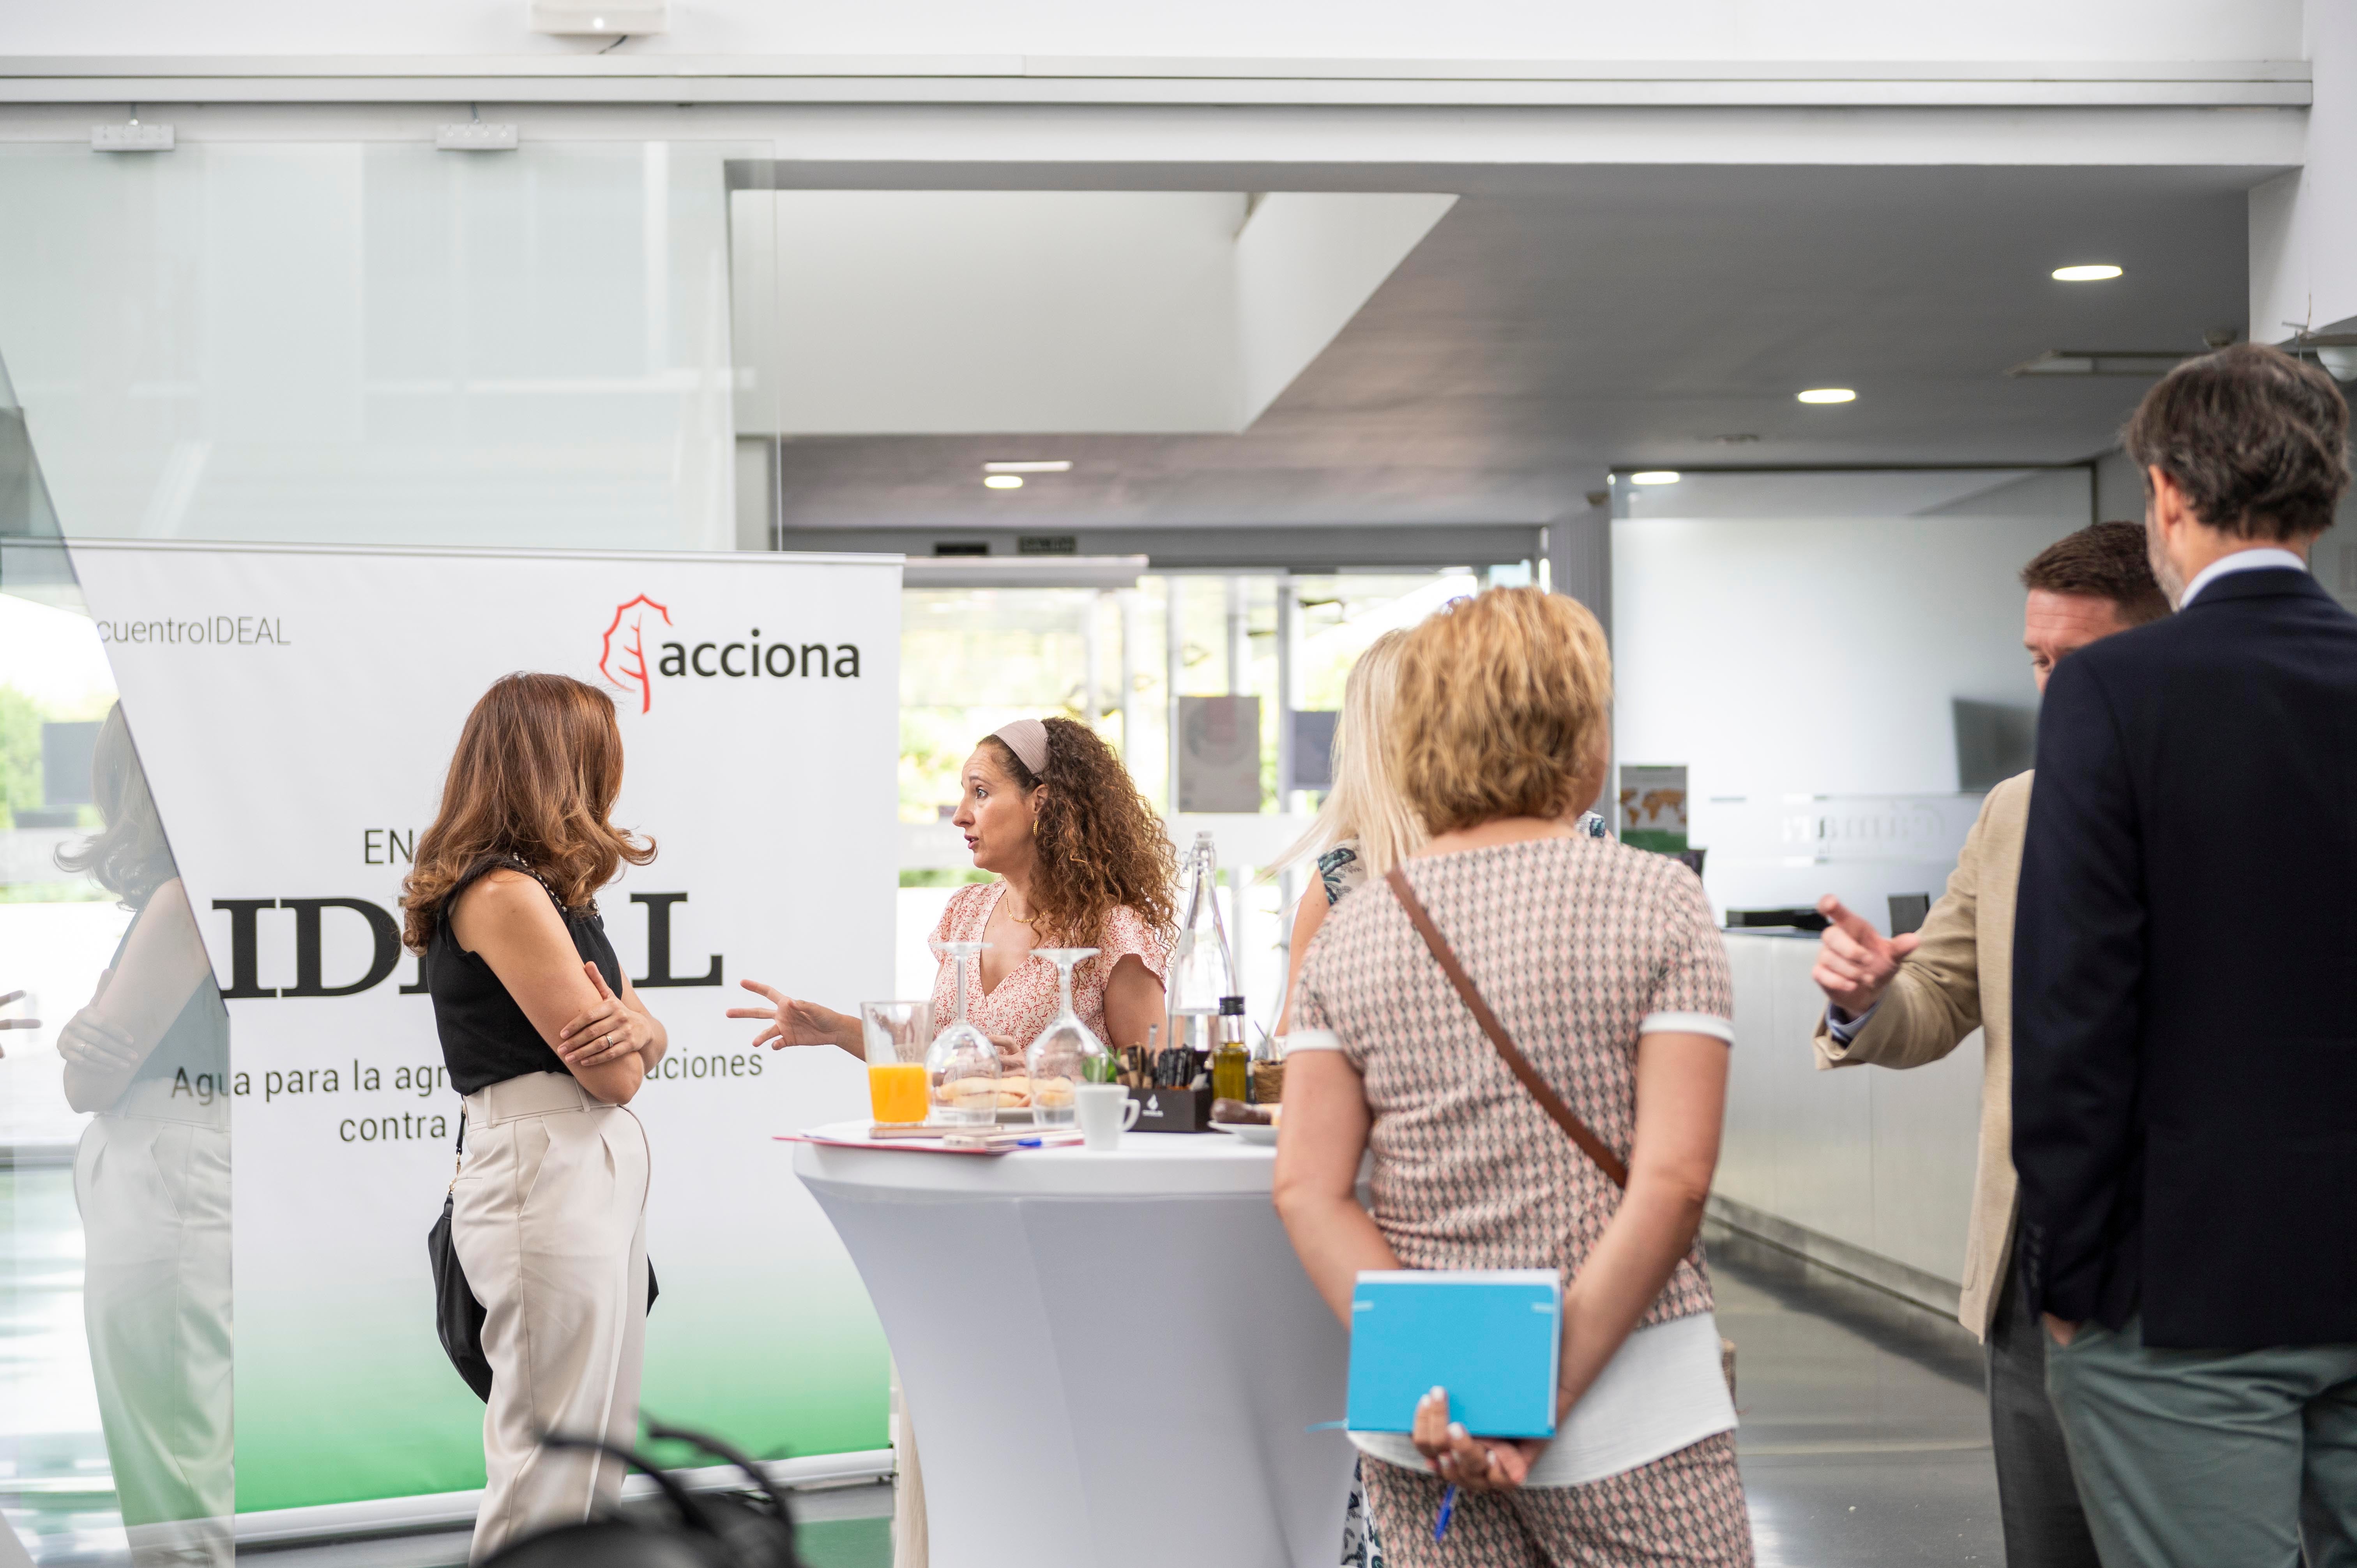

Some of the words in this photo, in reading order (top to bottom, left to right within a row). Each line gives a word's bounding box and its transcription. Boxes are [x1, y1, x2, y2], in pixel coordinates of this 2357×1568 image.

[97, 616, 291, 645] cuentroIDEAL
[659, 627, 860, 678] acciona
[212, 891, 723, 999] IDL
[171, 1065, 250, 1106] Agua
[266, 1067, 339, 1103] para
[354, 1058, 381, 1091] la
[339, 1111, 447, 1142] contra
